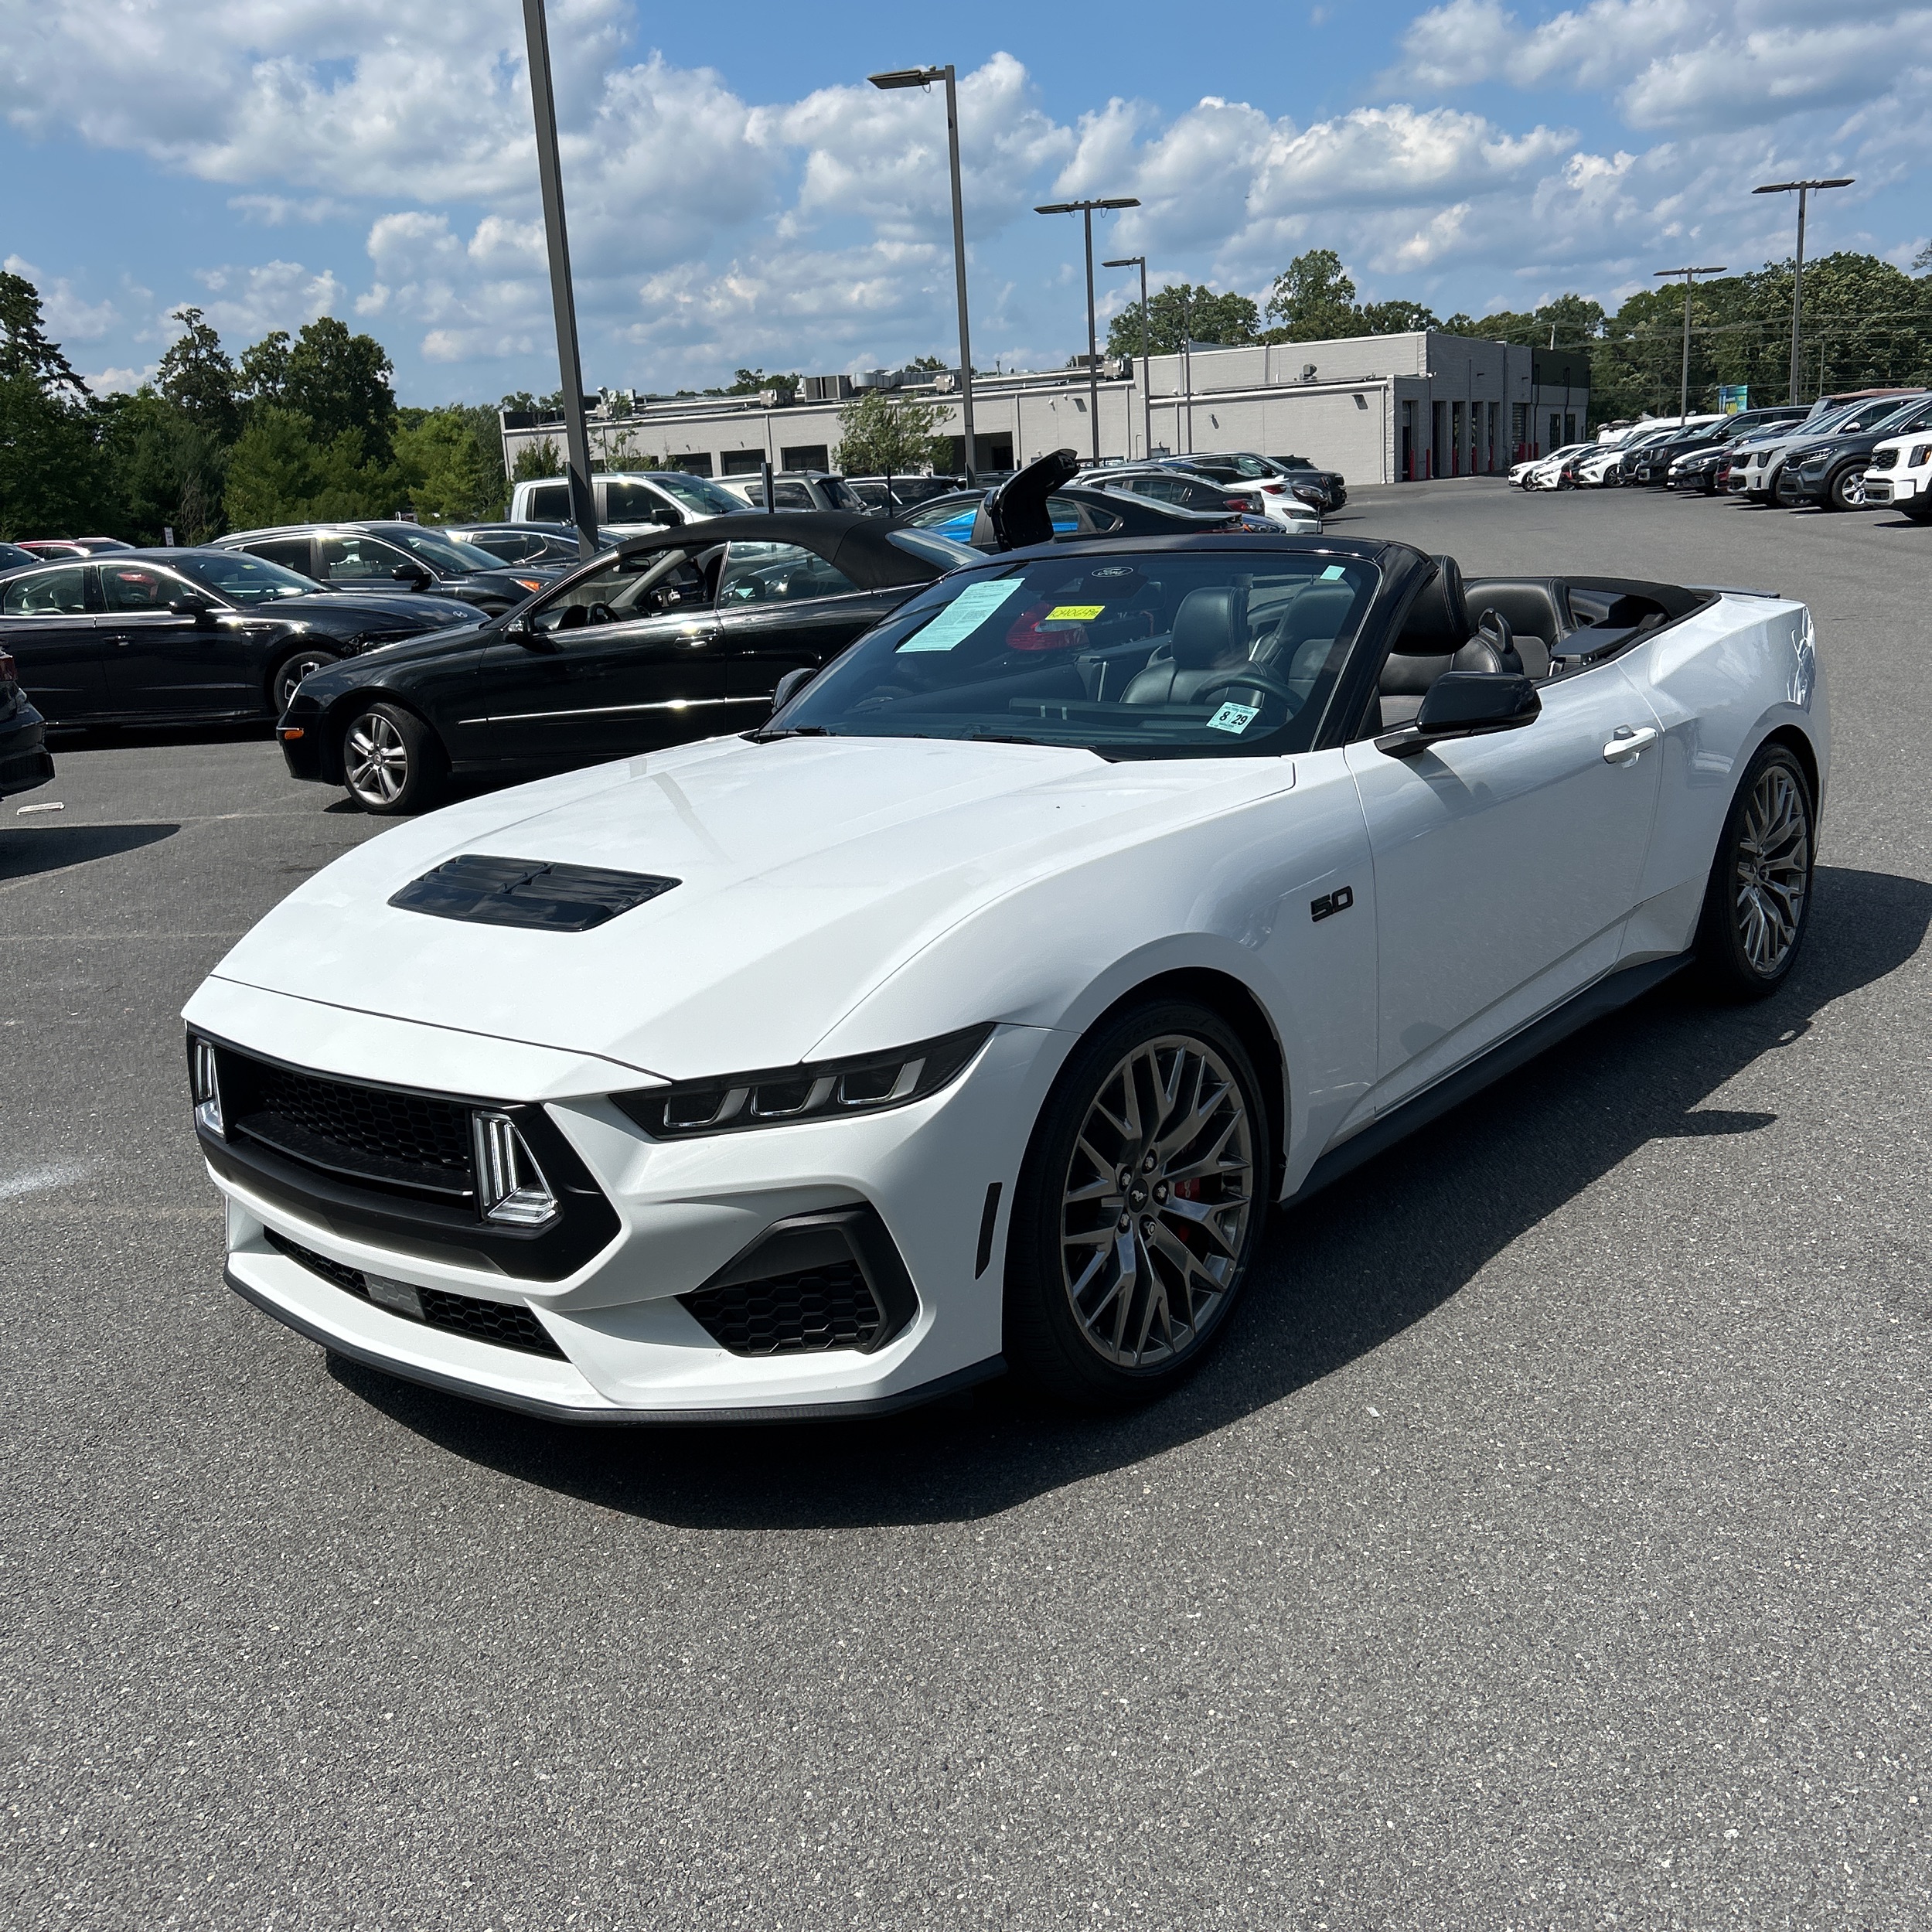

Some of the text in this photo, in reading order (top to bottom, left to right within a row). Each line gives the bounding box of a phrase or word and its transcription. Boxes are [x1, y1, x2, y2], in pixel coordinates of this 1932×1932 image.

[1096, 567, 1128, 576] Ford
[1219, 711, 1249, 725] 8 29
